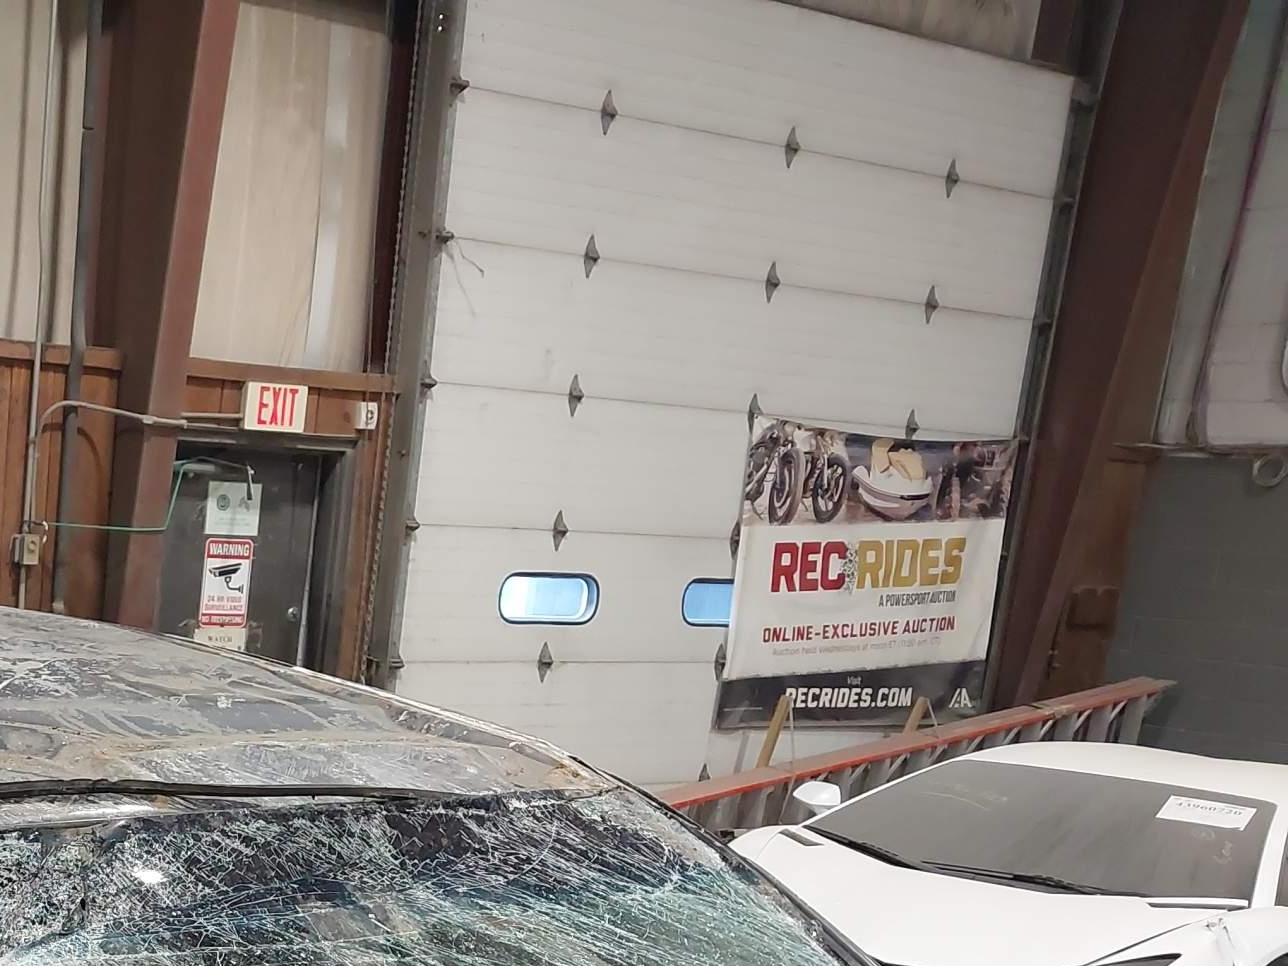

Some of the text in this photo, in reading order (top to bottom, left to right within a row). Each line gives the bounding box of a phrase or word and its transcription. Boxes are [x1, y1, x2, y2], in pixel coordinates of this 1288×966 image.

[257, 385, 300, 427] EXIT
[209, 542, 250, 557] WARNING
[770, 537, 967, 593] REC RIDES
[878, 590, 957, 607] A POWERSPORT AUCTION
[762, 616, 956, 643] ONLINE-EXCLUSIVE AUCTION
[847, 675, 862, 686] Visit
[785, 686, 913, 709] RECRIDES.COM
